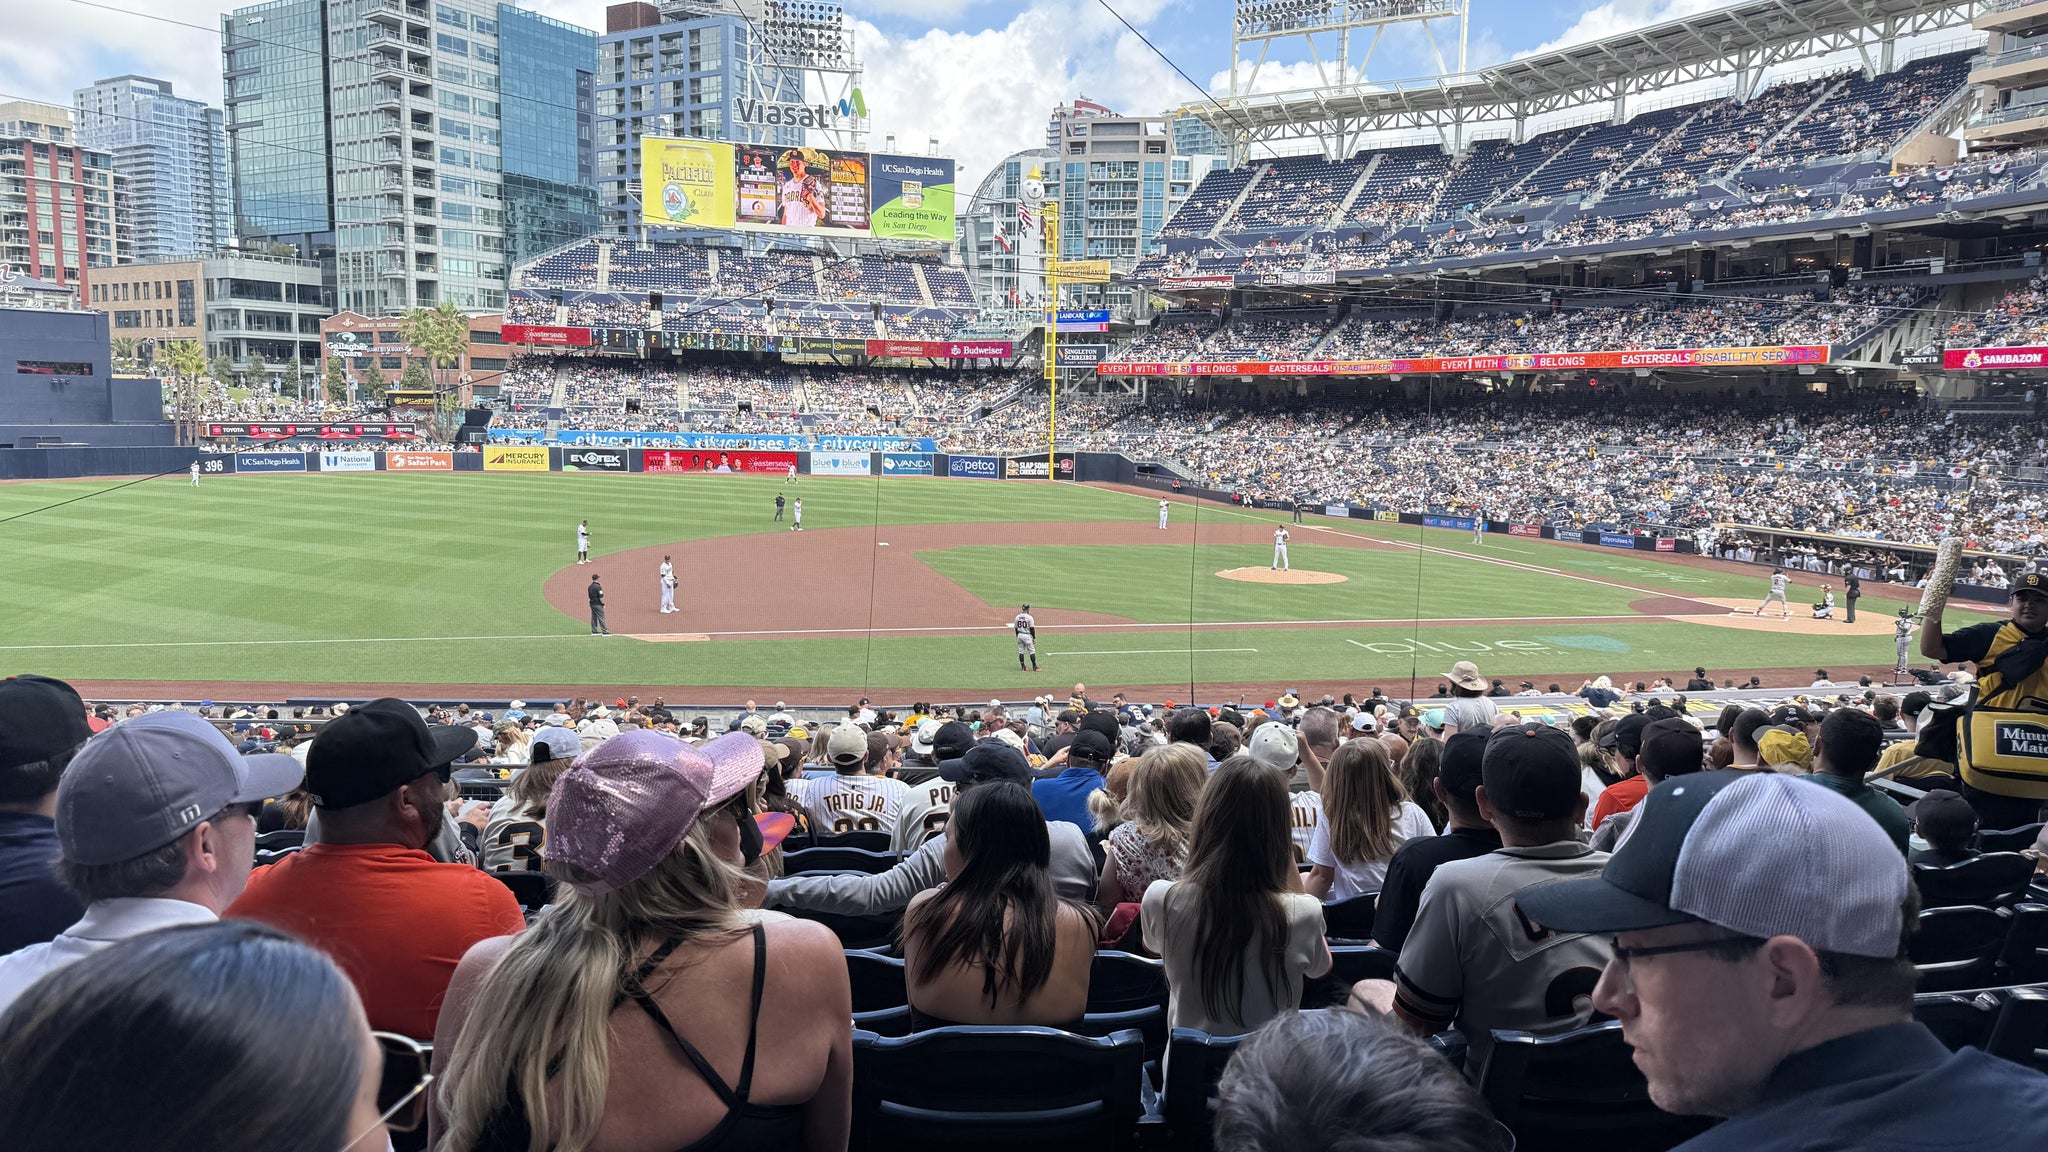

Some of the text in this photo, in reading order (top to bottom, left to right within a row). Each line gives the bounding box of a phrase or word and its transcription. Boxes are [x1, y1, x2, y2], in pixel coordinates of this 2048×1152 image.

[737, 98, 829, 128] Viasat
[882, 164, 944, 176] UC San Diego Health
[883, 210, 947, 222] Leading the Way
[908, 222, 927, 231] Diego
[651, 335, 657, 343] F
[709, 333, 714, 341] 2
[326, 342, 368, 351] Gallagher
[674, 340, 679, 348] 4
[722, 338, 726, 346] 7
[332, 350, 363, 358] Square
[963, 345, 1003, 354] Budweiser
[1135, 365, 1157, 373] WITH
[1196, 365, 1238, 373] BELONGS
[1269, 364, 1329, 373] EASTERSEALS
[1331, 363, 1377, 372] DISABILITY
[1378, 362, 1412, 371] SERVICES
[1475, 359, 1498, 369] WITH
[1540, 356, 1586, 367] BELONGS
[1621, 353, 1691, 365] EASTERSEALS
[1694, 352, 1758, 363] DISABILITY
[1761, 350, 1820, 361] SERVICES
[1983, 353, 2042, 364] SAMBAZON
[264, 458, 281, 466] Diego
[571, 452, 620, 464] EVOTEK
[812, 457, 831, 466] blue
[842, 457, 860, 466] blue
[205, 460, 223, 471] 396
[895, 460, 932, 468] VANDA
[965, 459, 995, 472] petco
[1601, 536, 1628, 544] citycruises
[1346, 638, 1550, 653] blue
[2003, 728, 2048, 741] Minu
[824, 793, 886, 814] TATIS JR.
